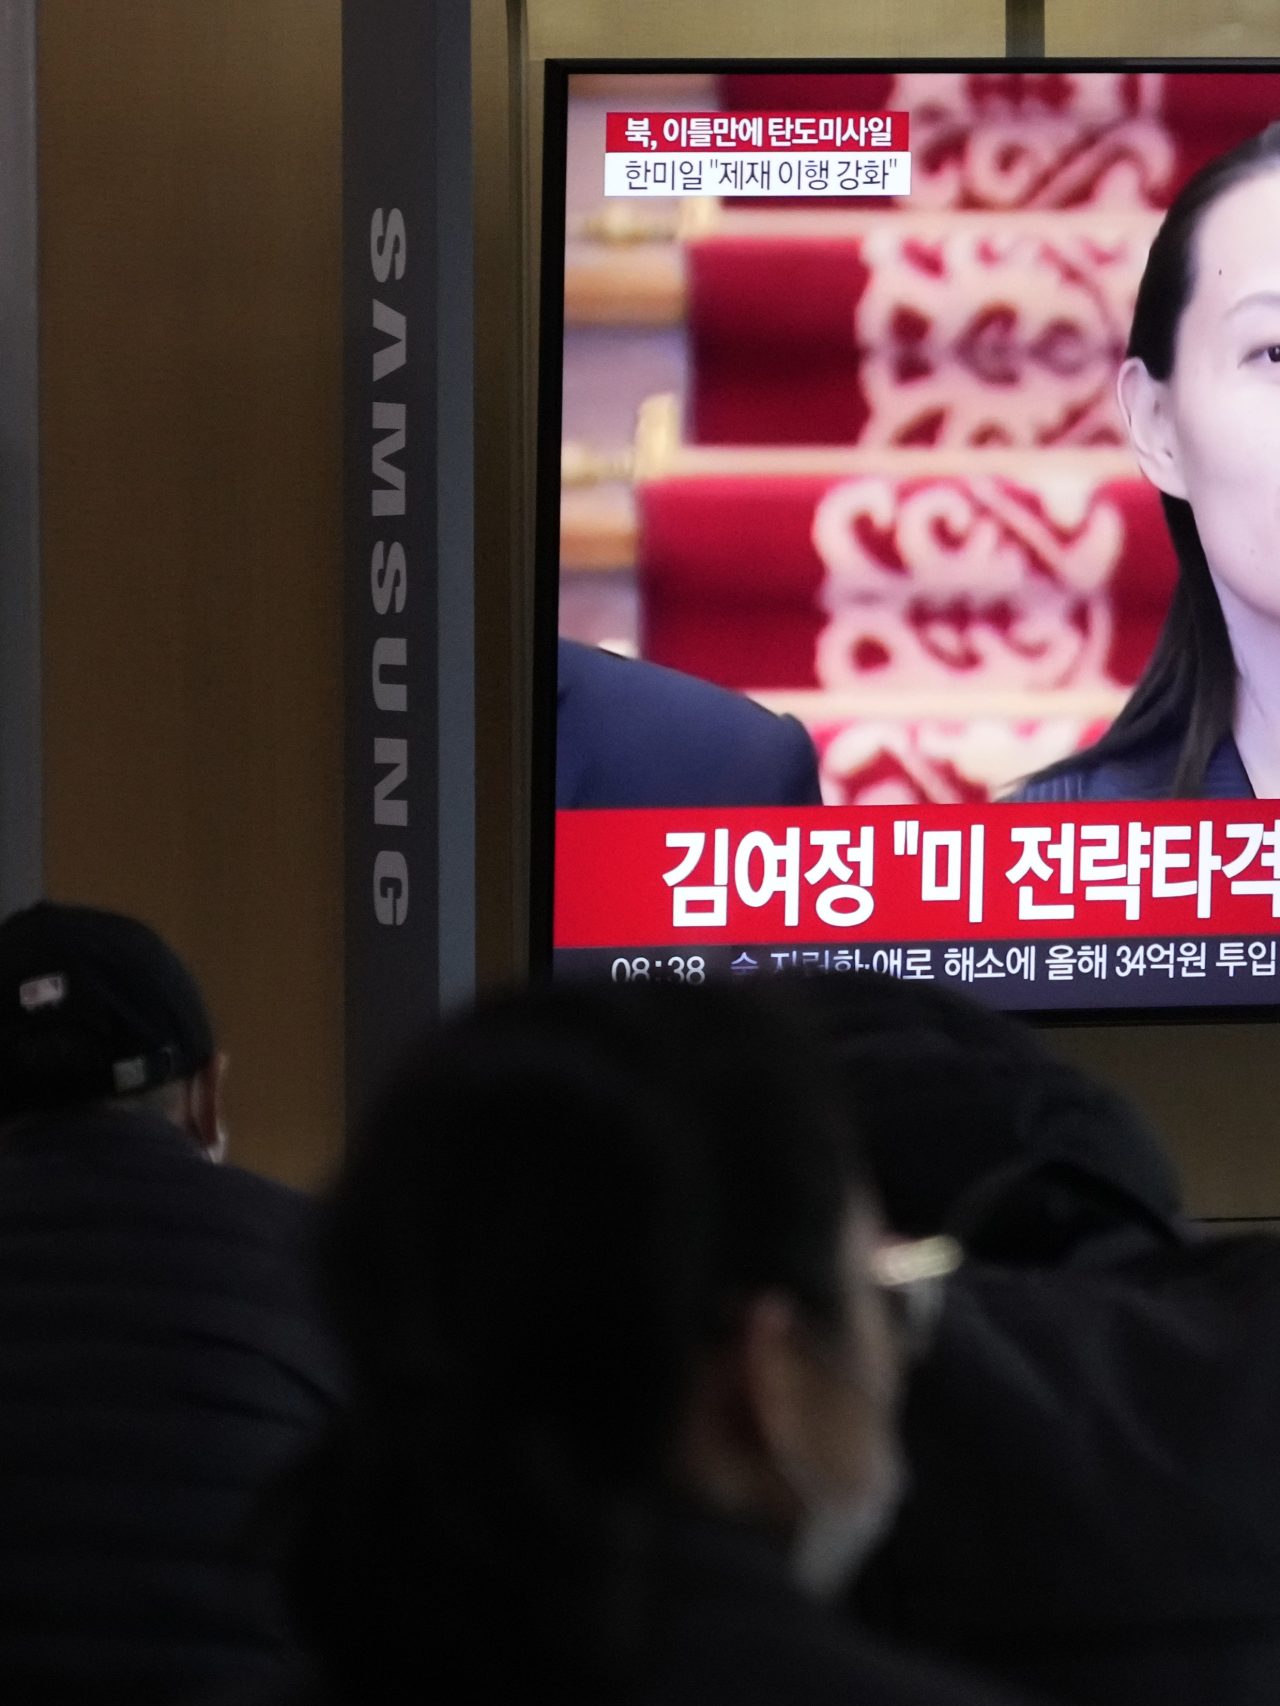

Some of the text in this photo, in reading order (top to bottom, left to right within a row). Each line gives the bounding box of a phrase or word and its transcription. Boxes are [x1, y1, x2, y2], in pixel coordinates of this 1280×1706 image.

[624, 116, 892, 150] 북, 이틀만에 탄도미사일
[625, 158, 897, 191] 한미일 "제재 이행 강화"
[370, 207, 409, 926] SAMSUNG
[662, 826, 875, 928] 김여정
[893, 820, 985, 923] "미
[611, 956, 705, 985] 08:38
[944, 945, 1036, 982] 해소에
[1045, 944, 1107, 981] 올해
[1115, 942, 1206, 979] 34억원
[1215, 941, 1276, 977] 투입
